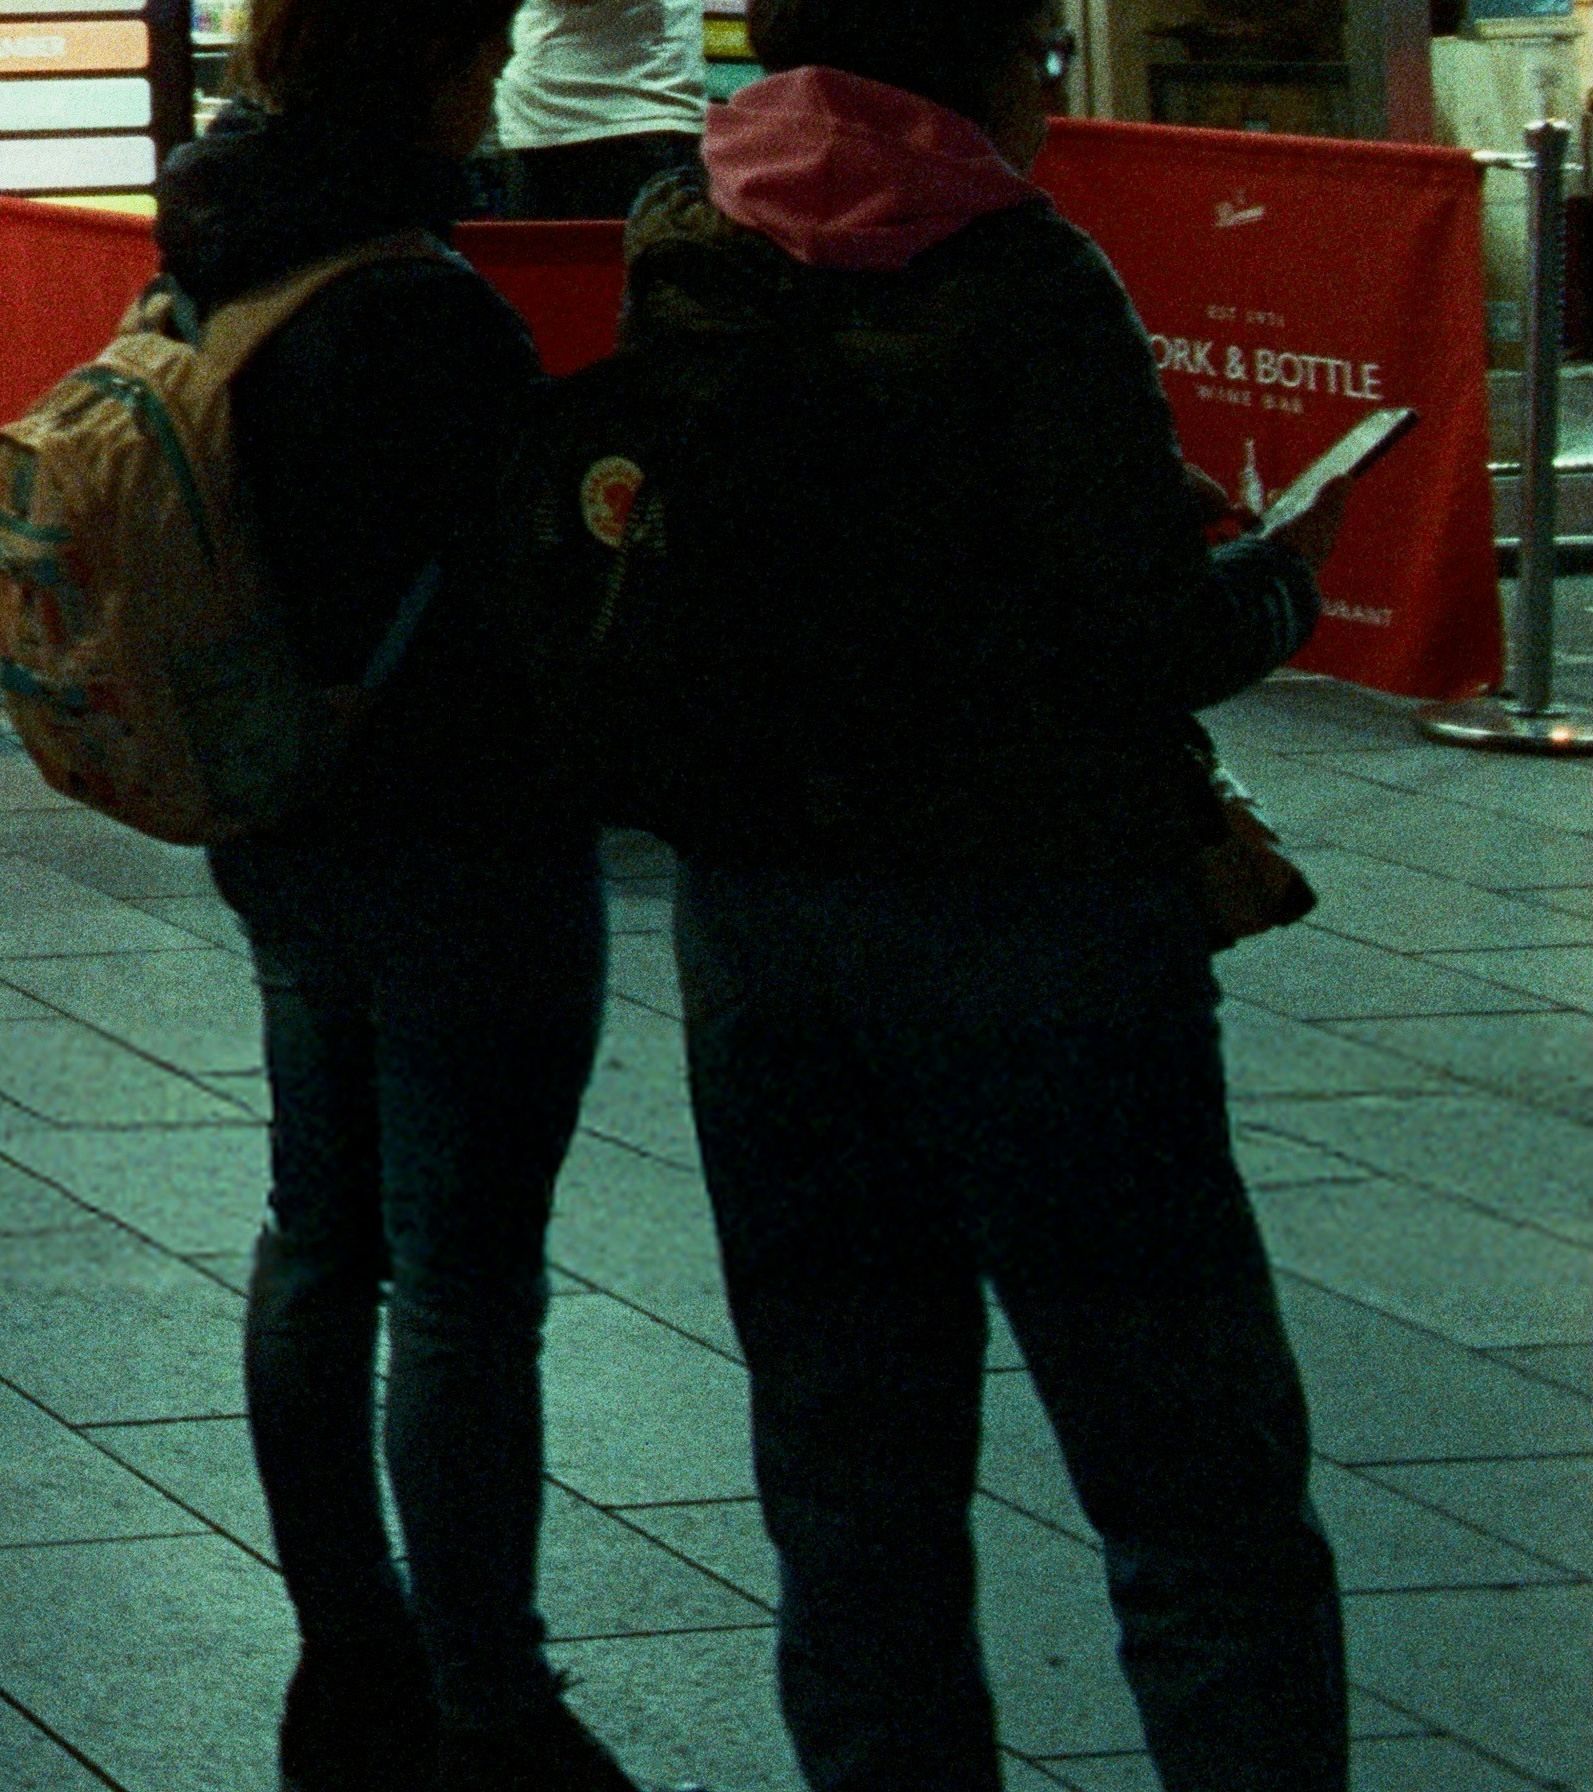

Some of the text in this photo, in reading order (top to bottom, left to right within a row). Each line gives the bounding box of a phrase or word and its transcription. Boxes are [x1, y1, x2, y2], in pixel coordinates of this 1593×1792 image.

[1149, 333, 1384, 400] ORK & BOTTLE
[1196, 384, 1253, 407] WINE
